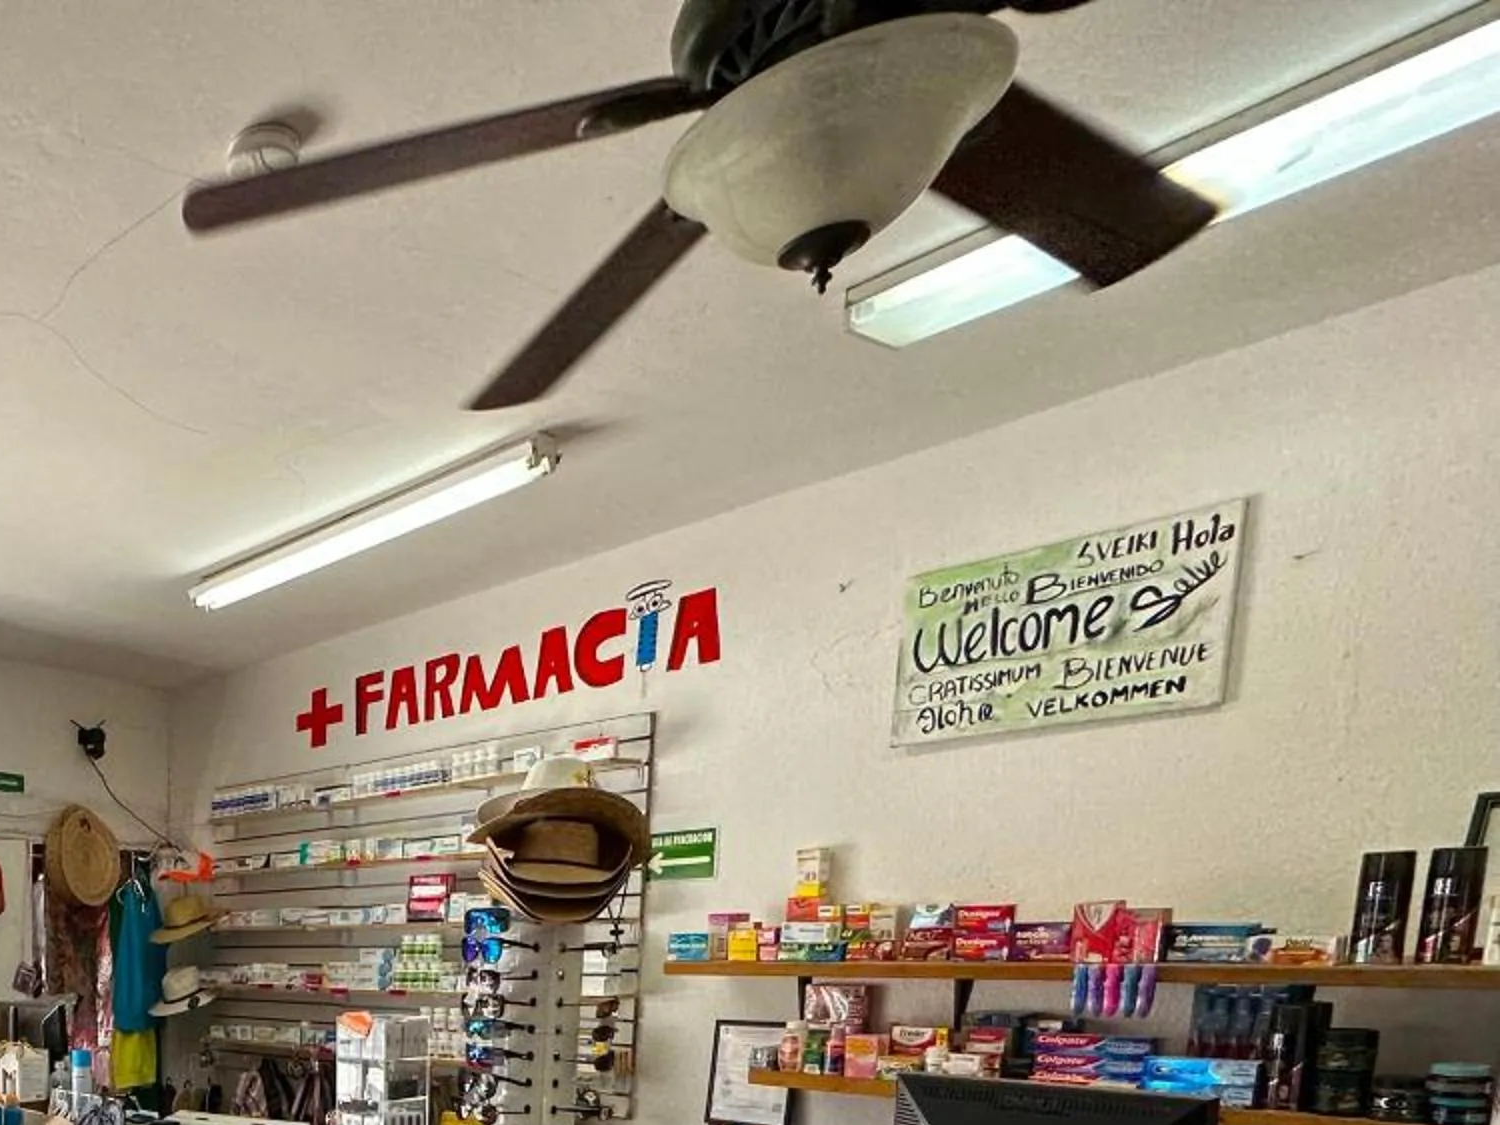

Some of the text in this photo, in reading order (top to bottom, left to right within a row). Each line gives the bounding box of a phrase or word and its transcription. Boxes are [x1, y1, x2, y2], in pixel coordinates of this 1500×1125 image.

[1076, 513, 1236, 569] SVEIKI Hola
[918, 558, 1165, 609] Benvenuto BIENVENIDO
[913, 596, 1115, 674] Welcome
[355, 587, 721, 736] FARMACIA
[1053, 640, 1211, 690] BIENVENUE
[1026, 675, 1188, 719] VELKOMMEN
[1036, 1053, 1087, 1067] Colgate
[1037, 1034, 1089, 1047] Colgate
